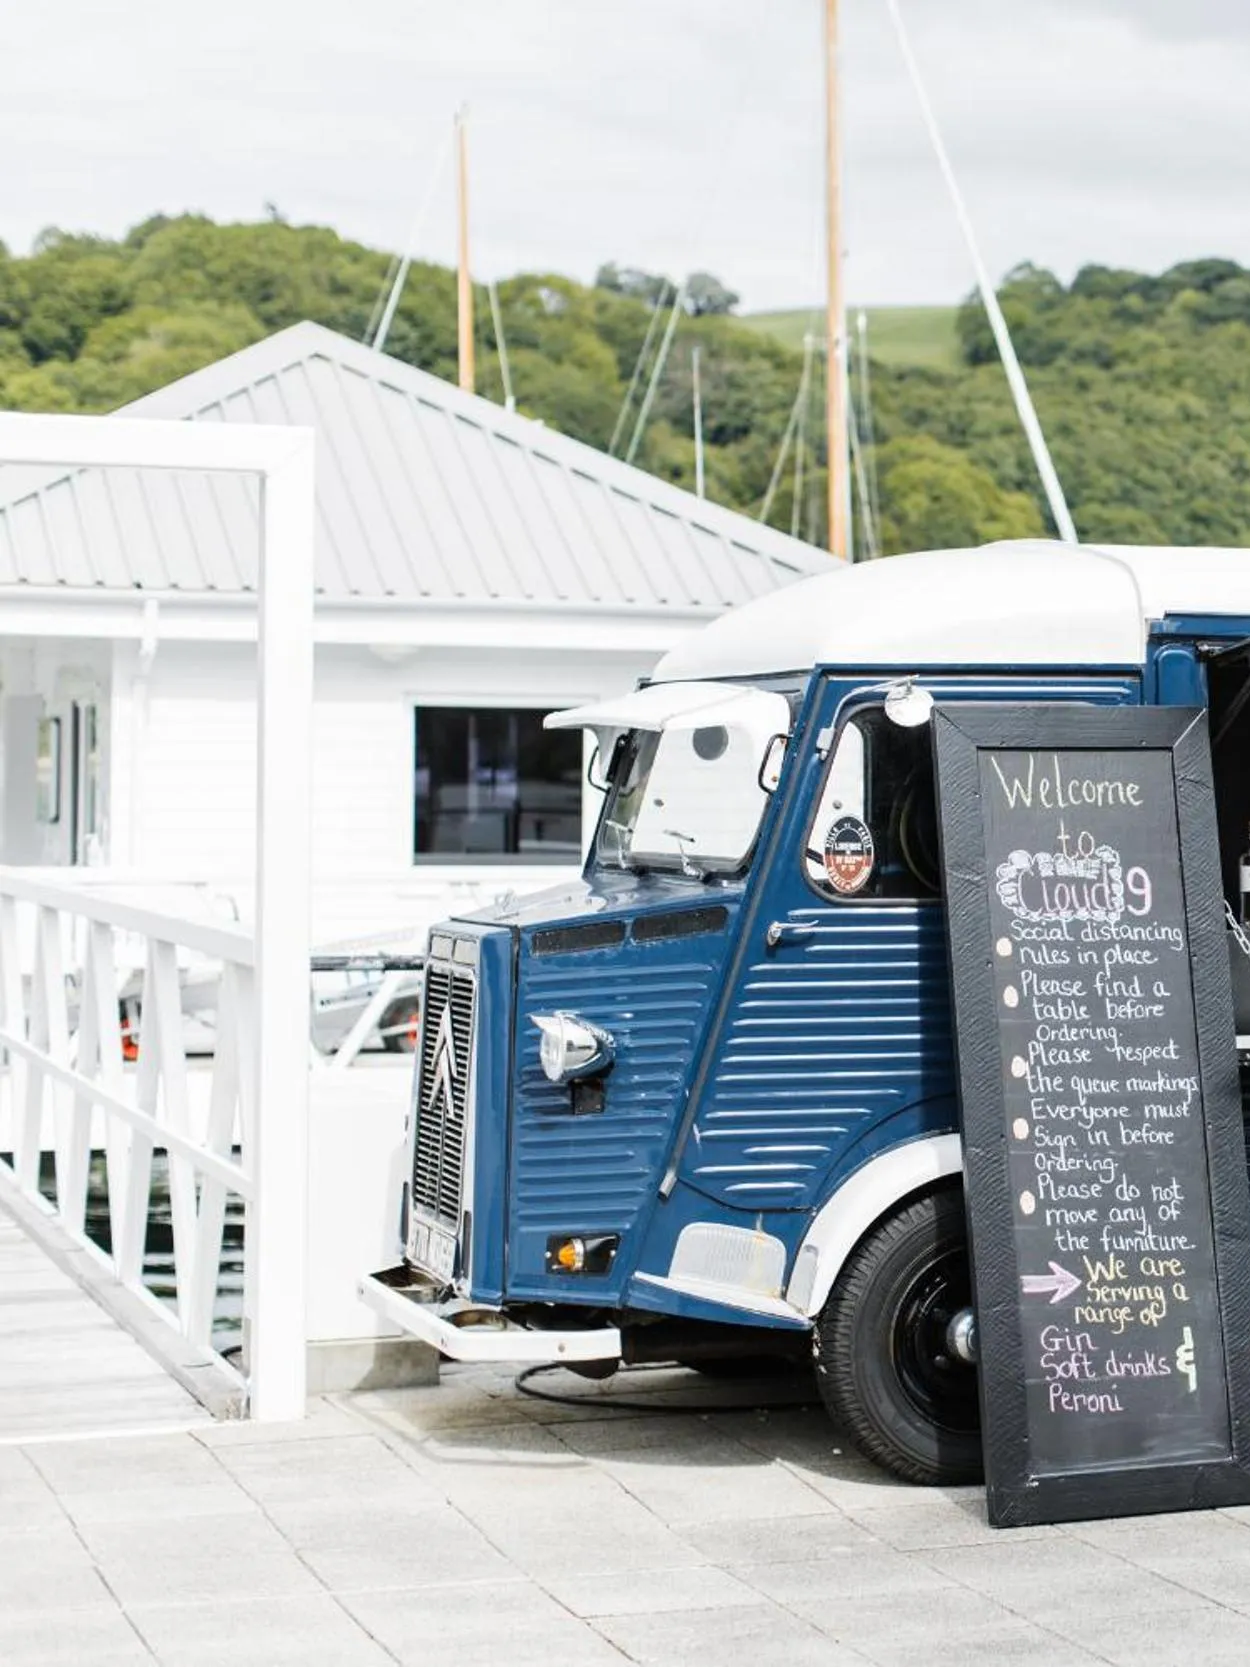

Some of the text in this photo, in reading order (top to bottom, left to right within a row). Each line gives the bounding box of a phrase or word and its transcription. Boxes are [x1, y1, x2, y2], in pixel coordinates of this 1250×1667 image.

[991, 752, 1143, 809] Welcome
[1057, 818, 1095, 860] to
[1018, 863, 1152, 916] Cloud 9
[1011, 919, 1184, 951] Social distancing
[1020, 944, 1158, 978] rules in place
[1021, 969, 1171, 998] Please find a
[1032, 997, 1165, 1021] table before
[1028, 1037, 1180, 1066] Please respect
[1024, 1060, 1199, 1106] the queue markings
[1031, 1098, 1190, 1129] Everyone must
[1034, 1121, 1175, 1158] Sign in before
[1037, 1173, 1185, 1201] Please do not
[1046, 1200, 1181, 1236] move any of
[1054, 1228, 1090, 1251] the
[1083, 1252, 1186, 1282] We are
[1172, 1282, 1190, 1301] a
[1074, 1302, 1164, 1334] range of
[1040, 1325, 1099, 1351] Gin
[1040, 1352, 1097, 1381] Soft
[1105, 1350, 1172, 1377] drinks
[1049, 1384, 1124, 1412] Peroni
